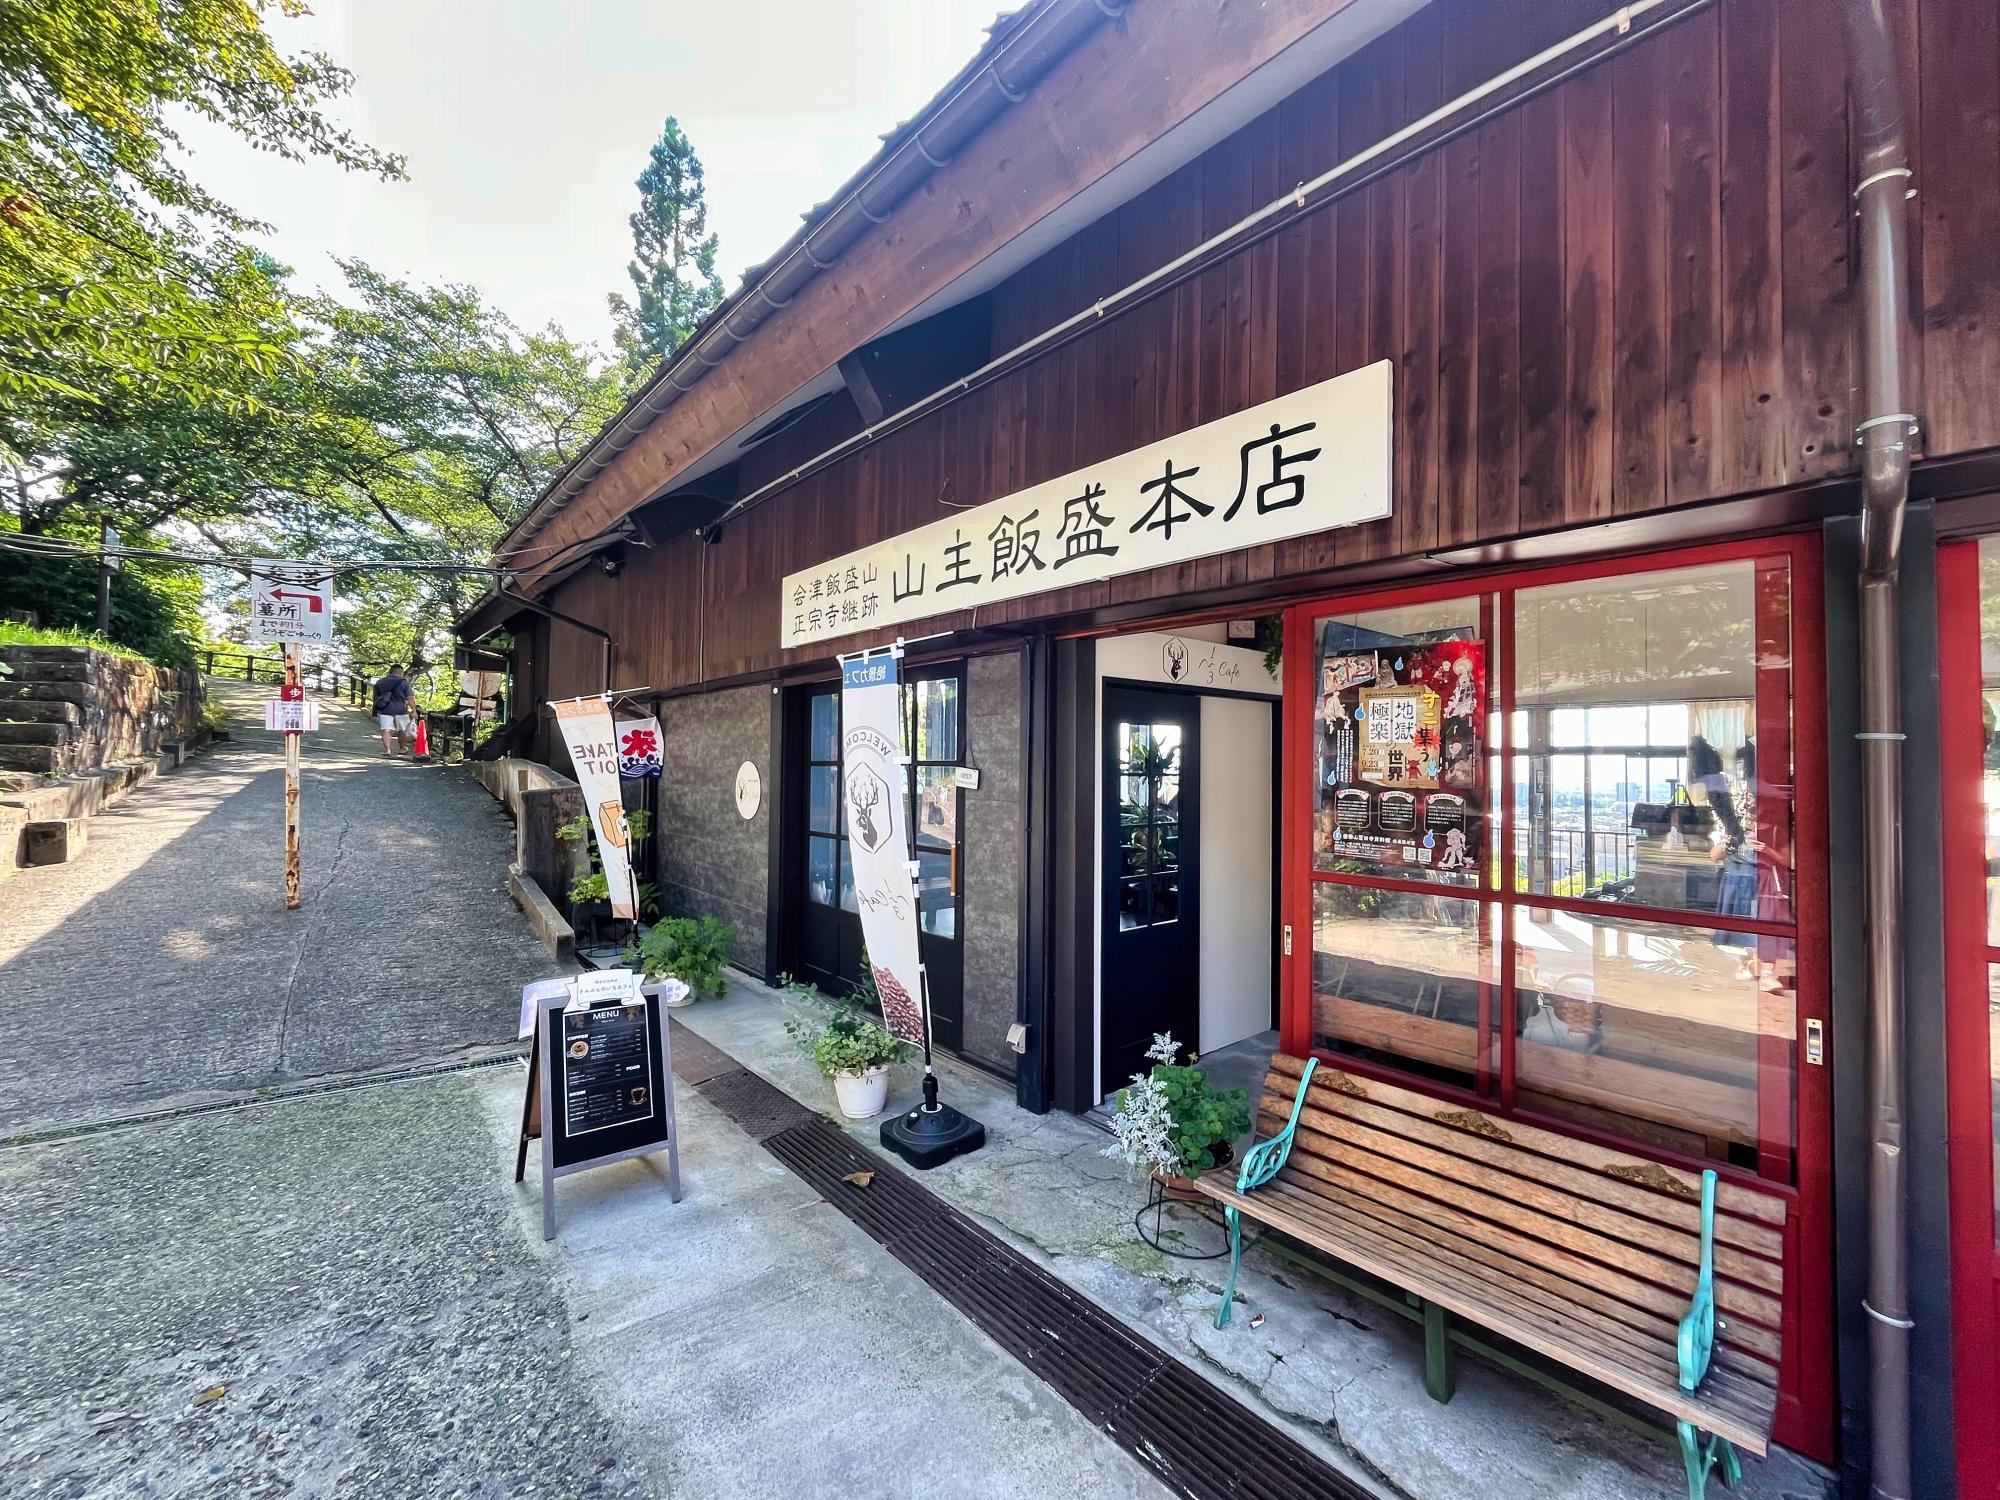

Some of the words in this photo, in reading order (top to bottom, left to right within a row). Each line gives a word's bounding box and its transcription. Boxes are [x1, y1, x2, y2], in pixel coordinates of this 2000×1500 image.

[892, 421, 1322, 604] 山主飯盛本店
[793, 562, 878, 606] 会津飯盛山
[257, 603, 297, 618] 墓所
[792, 592, 879, 635] 正宗寺継跡
[592, 1010, 619, 1020] MENU
